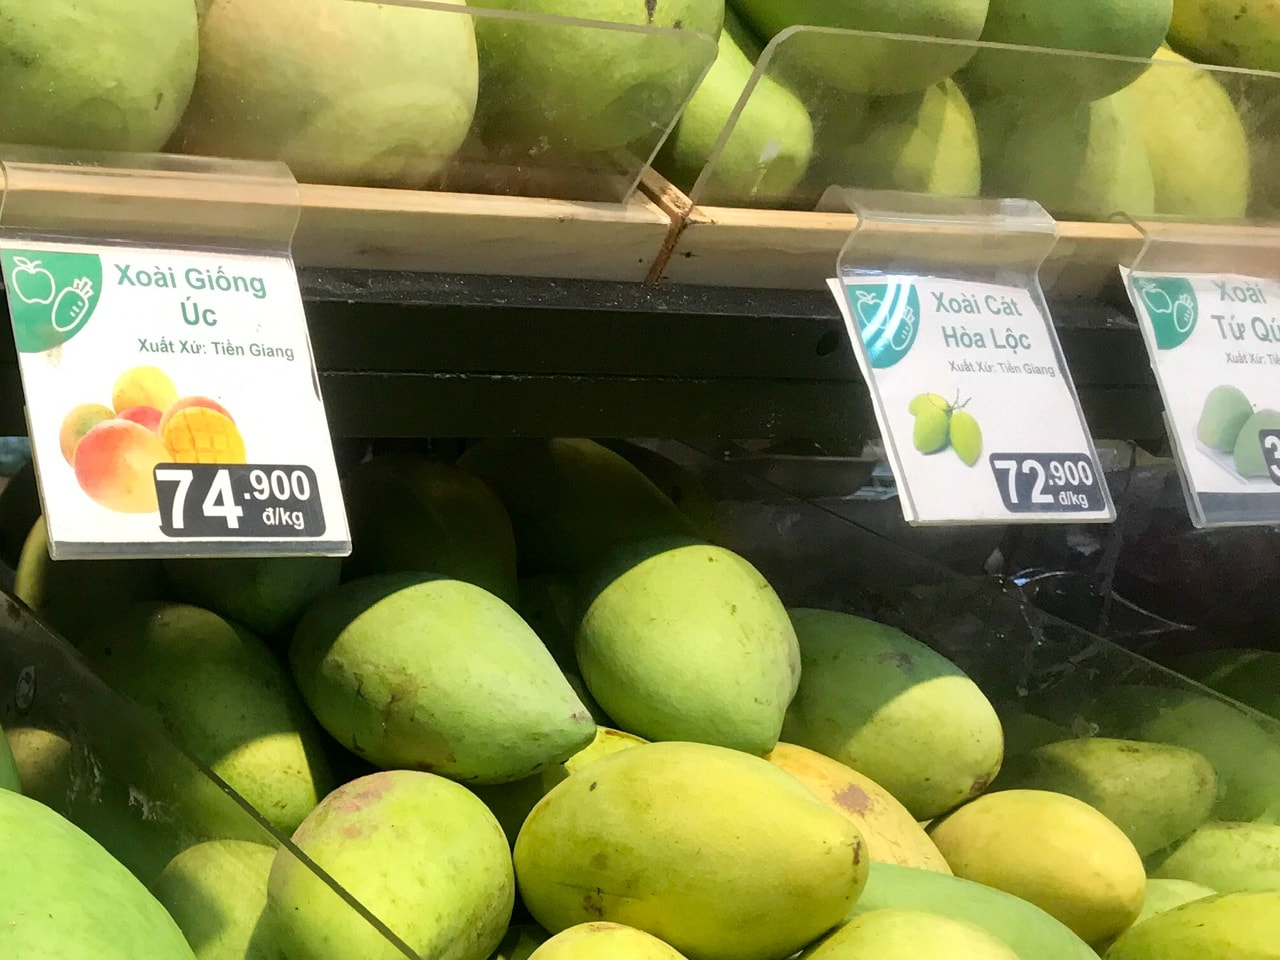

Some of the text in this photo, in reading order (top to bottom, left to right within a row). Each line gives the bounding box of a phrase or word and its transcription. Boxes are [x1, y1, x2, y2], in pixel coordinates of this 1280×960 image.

[113, 263, 268, 300] Xoài Giống
[1210, 279, 1268, 304] Xoài
[180, 295, 218, 327] Úc
[930, 290, 1024, 317] Xoài Cát
[941, 325, 1032, 356] Hòa Lộc
[1209, 314, 1247, 341] Tứ
[137, 335, 296, 362] Xuất Xứ: Tiền Giang
[997, 360, 1021, 374] Tiền
[1022, 362, 1057, 378] Giang
[1058, 490, 1090, 509] đ/kg
[261, 506, 305, 531] đ/kg
